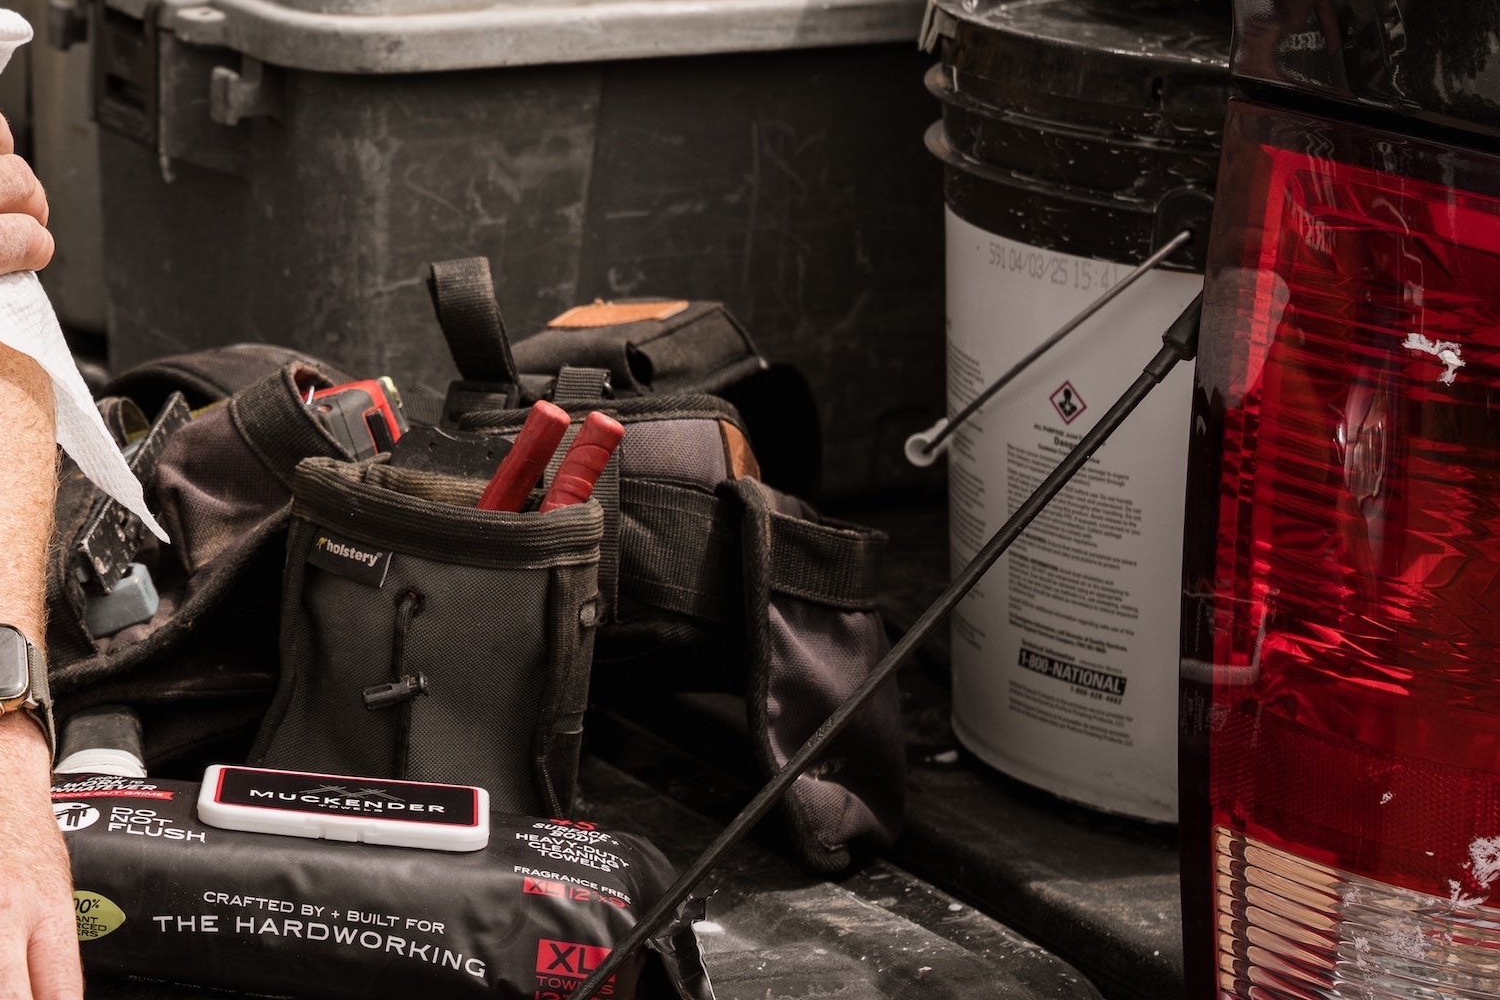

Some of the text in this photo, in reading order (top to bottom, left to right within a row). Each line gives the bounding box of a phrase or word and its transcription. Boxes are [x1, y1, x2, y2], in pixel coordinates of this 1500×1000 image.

[1009, 248, 1068, 285] 04/03/25
[326, 539, 379, 567] holstery
[1020, 650, 1122, 693] 1-800-NATIONAL
[111, 806, 156, 818] DO
[249, 789, 446, 814] MUCKENDER
[318, 803, 383, 812] TOWELS
[107, 823, 207, 844] FLUSH
[109, 814, 174, 827] NOT
[532, 822, 611, 842] SURFACE
[515, 832, 630, 868] HEAVY-DUTY
[549, 830, 600, 845] BODY
[528, 841, 620, 869] CLEANING
[537, 849, 612, 872] TOWELS
[513, 865, 632, 905] FRAGRANCE FREE
[202, 890, 295, 914] CRAFTED
[301, 903, 326, 918] BY
[346, 909, 401, 928] BUILT
[405, 917, 446, 935] FOR
[152, 914, 487, 978] THE HARDWORKING
[547, 942, 596, 974] XL
